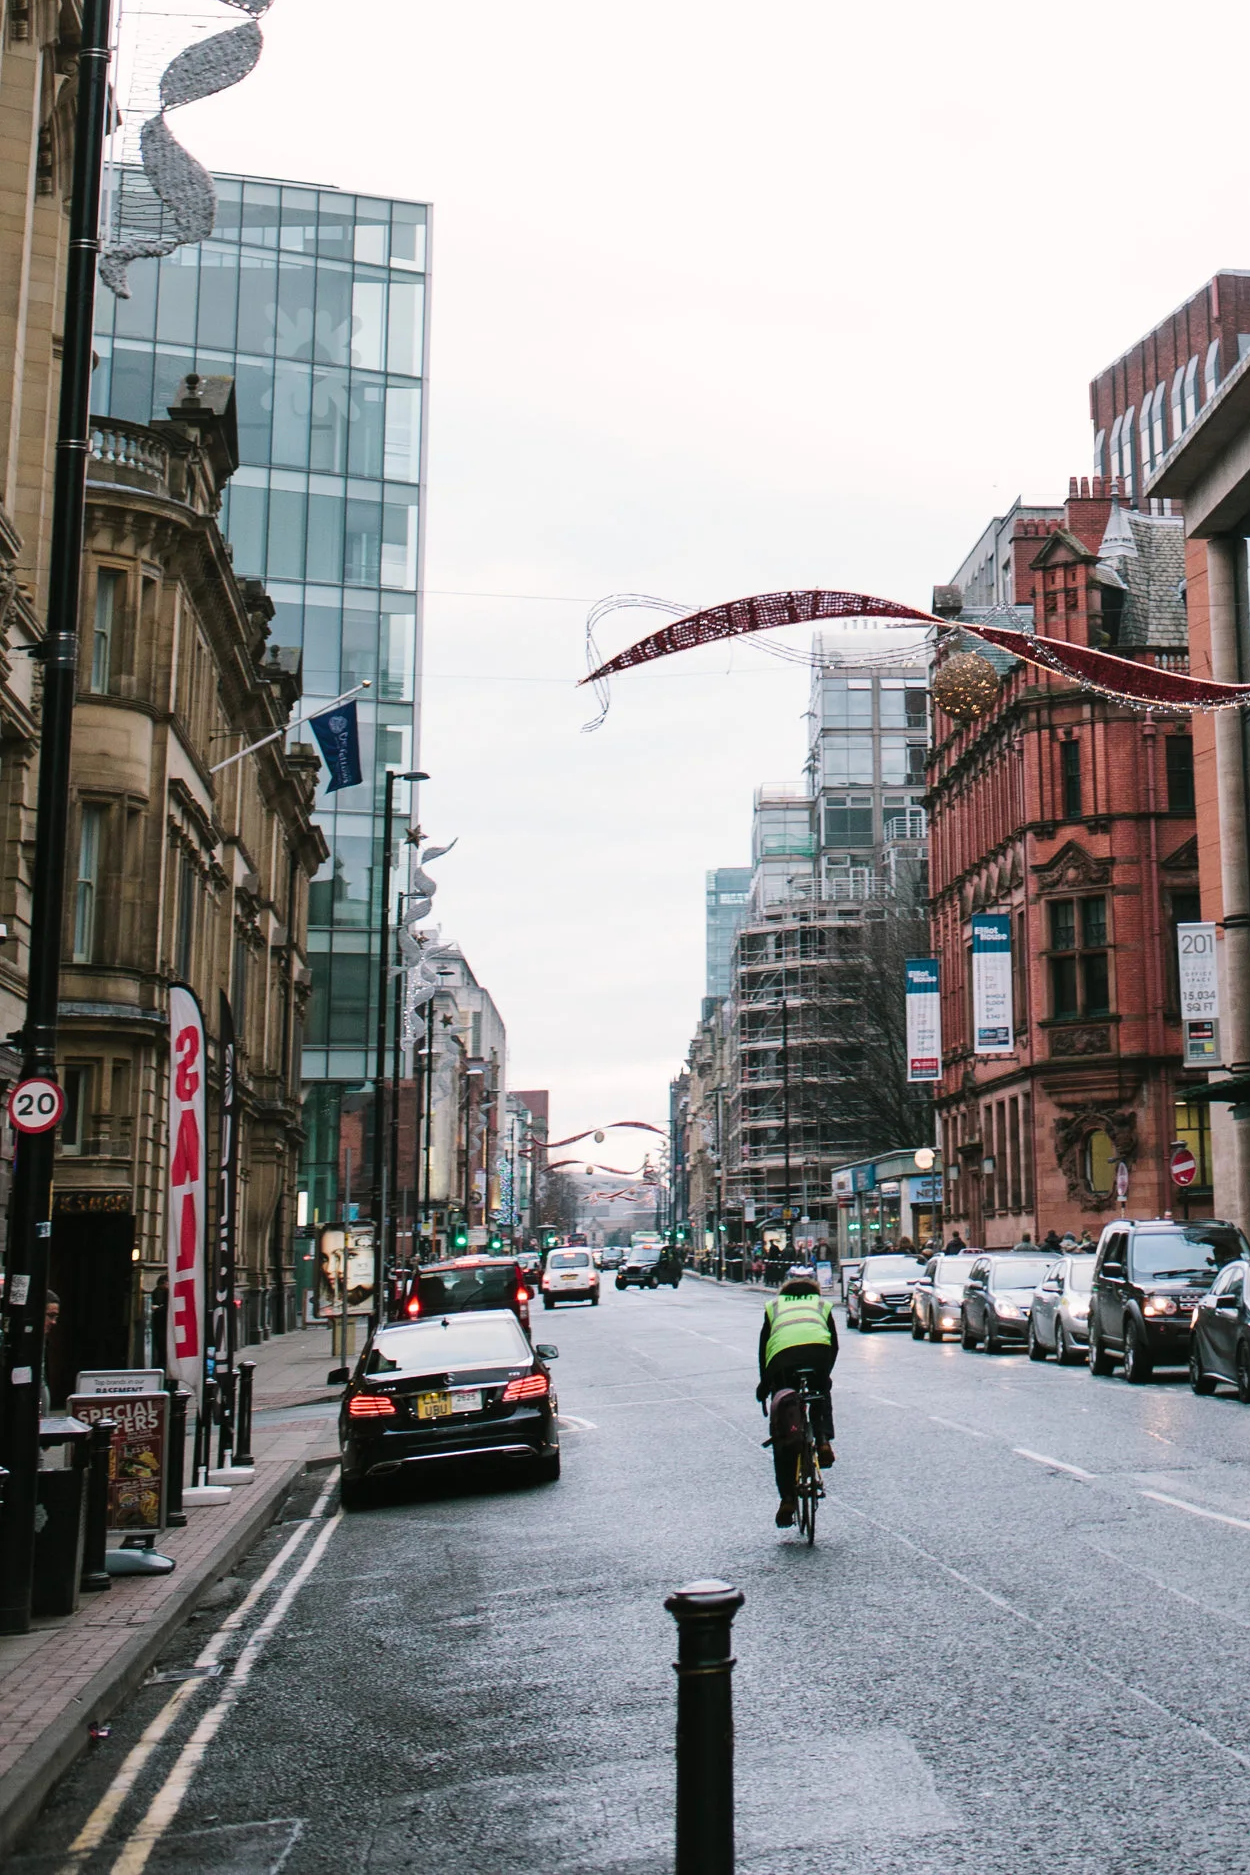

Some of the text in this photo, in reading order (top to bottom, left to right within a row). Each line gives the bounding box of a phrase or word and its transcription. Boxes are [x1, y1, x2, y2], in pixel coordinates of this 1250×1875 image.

[1181, 934, 1214, 954] 201
[1183, 991, 1216, 1001] 15,034
[1186, 1002, 1213, 1012] SQ FT
[17, 1092, 56, 1116] 20
[78, 1400, 158, 1423] SPECIAL
[424, 1404, 448, 1417] UBU
[114, 1413, 159, 1434] FERS
